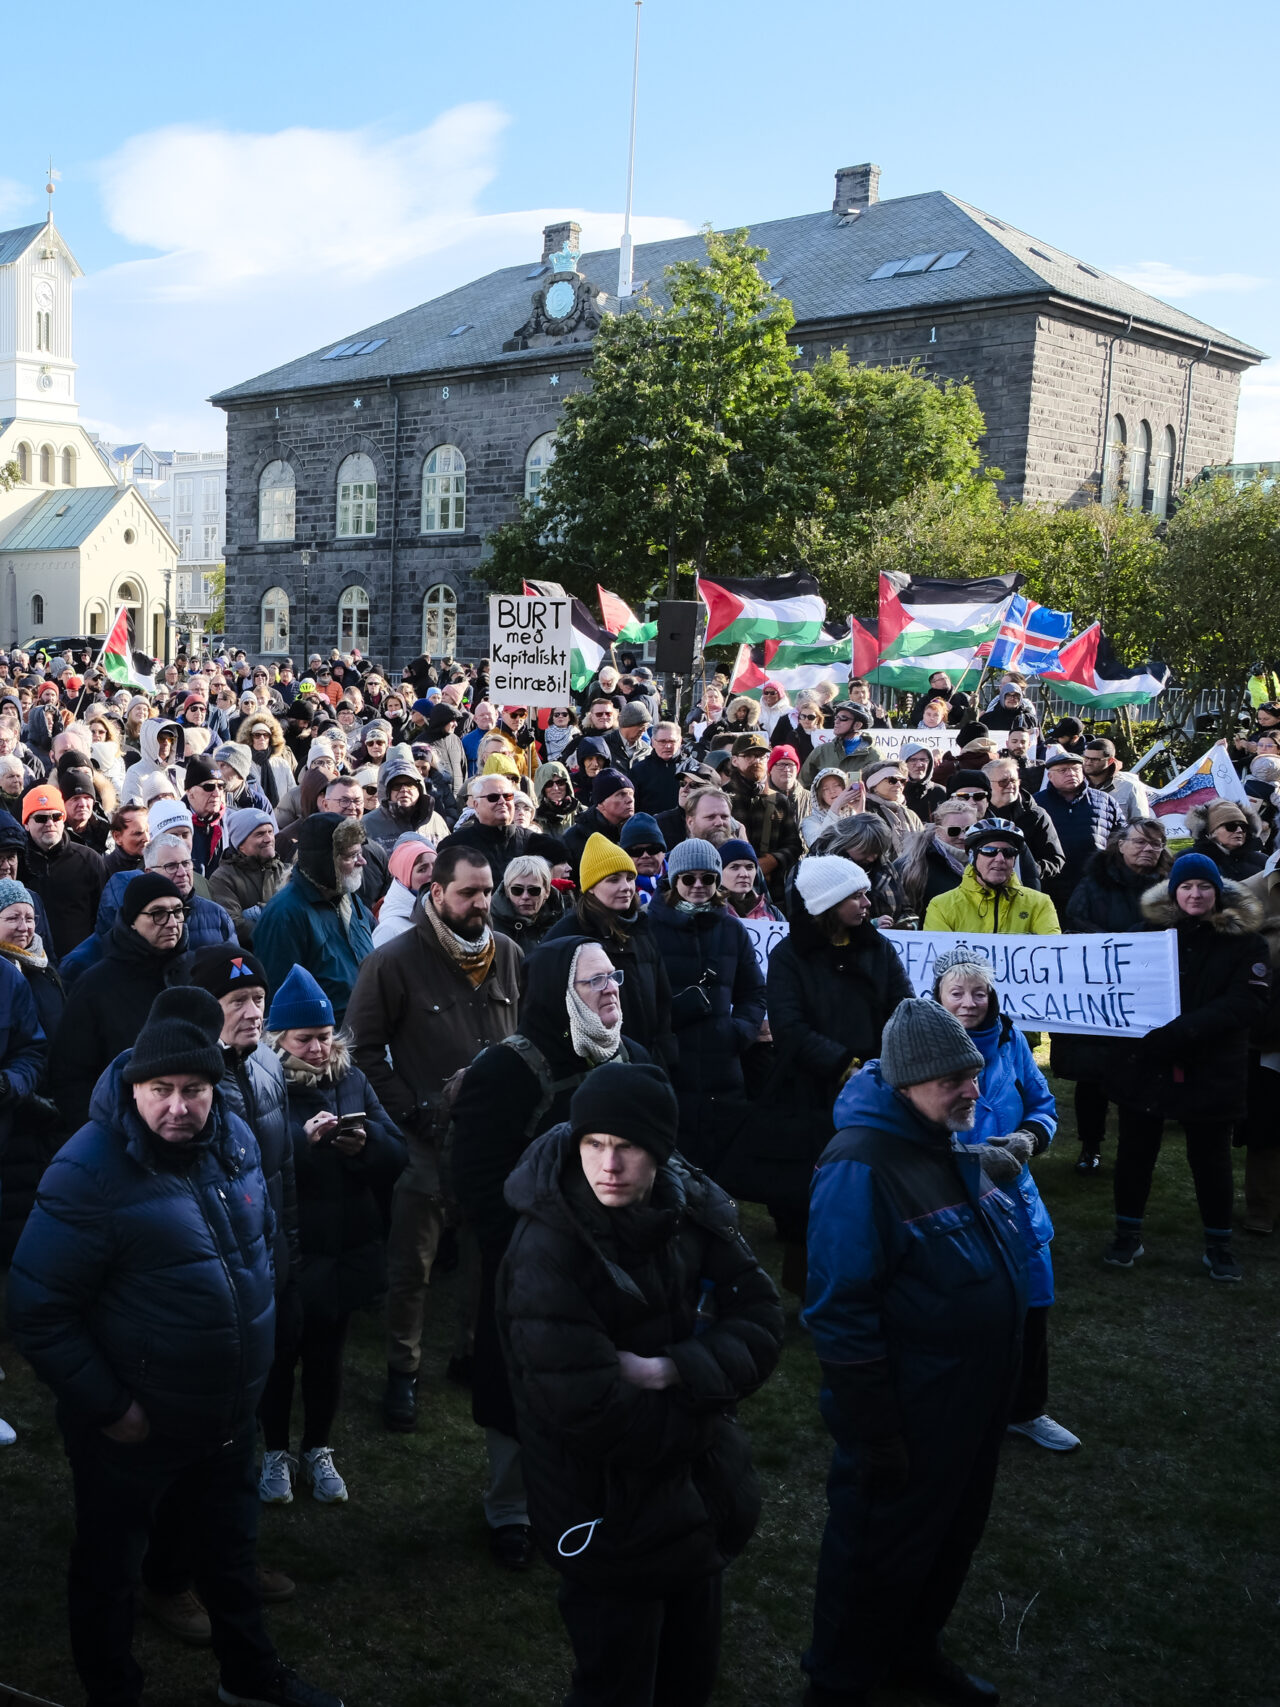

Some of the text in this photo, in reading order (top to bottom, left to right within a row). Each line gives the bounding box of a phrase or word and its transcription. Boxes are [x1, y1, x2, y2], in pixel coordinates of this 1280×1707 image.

[498, 600, 566, 629] BURT
[506, 629, 543, 644] með
[492, 643, 566, 669] Kapítalískt
[495, 670, 566, 693] einræði!
[874, 735, 898, 747] AND
[1083, 938, 1133, 984] LÍF
